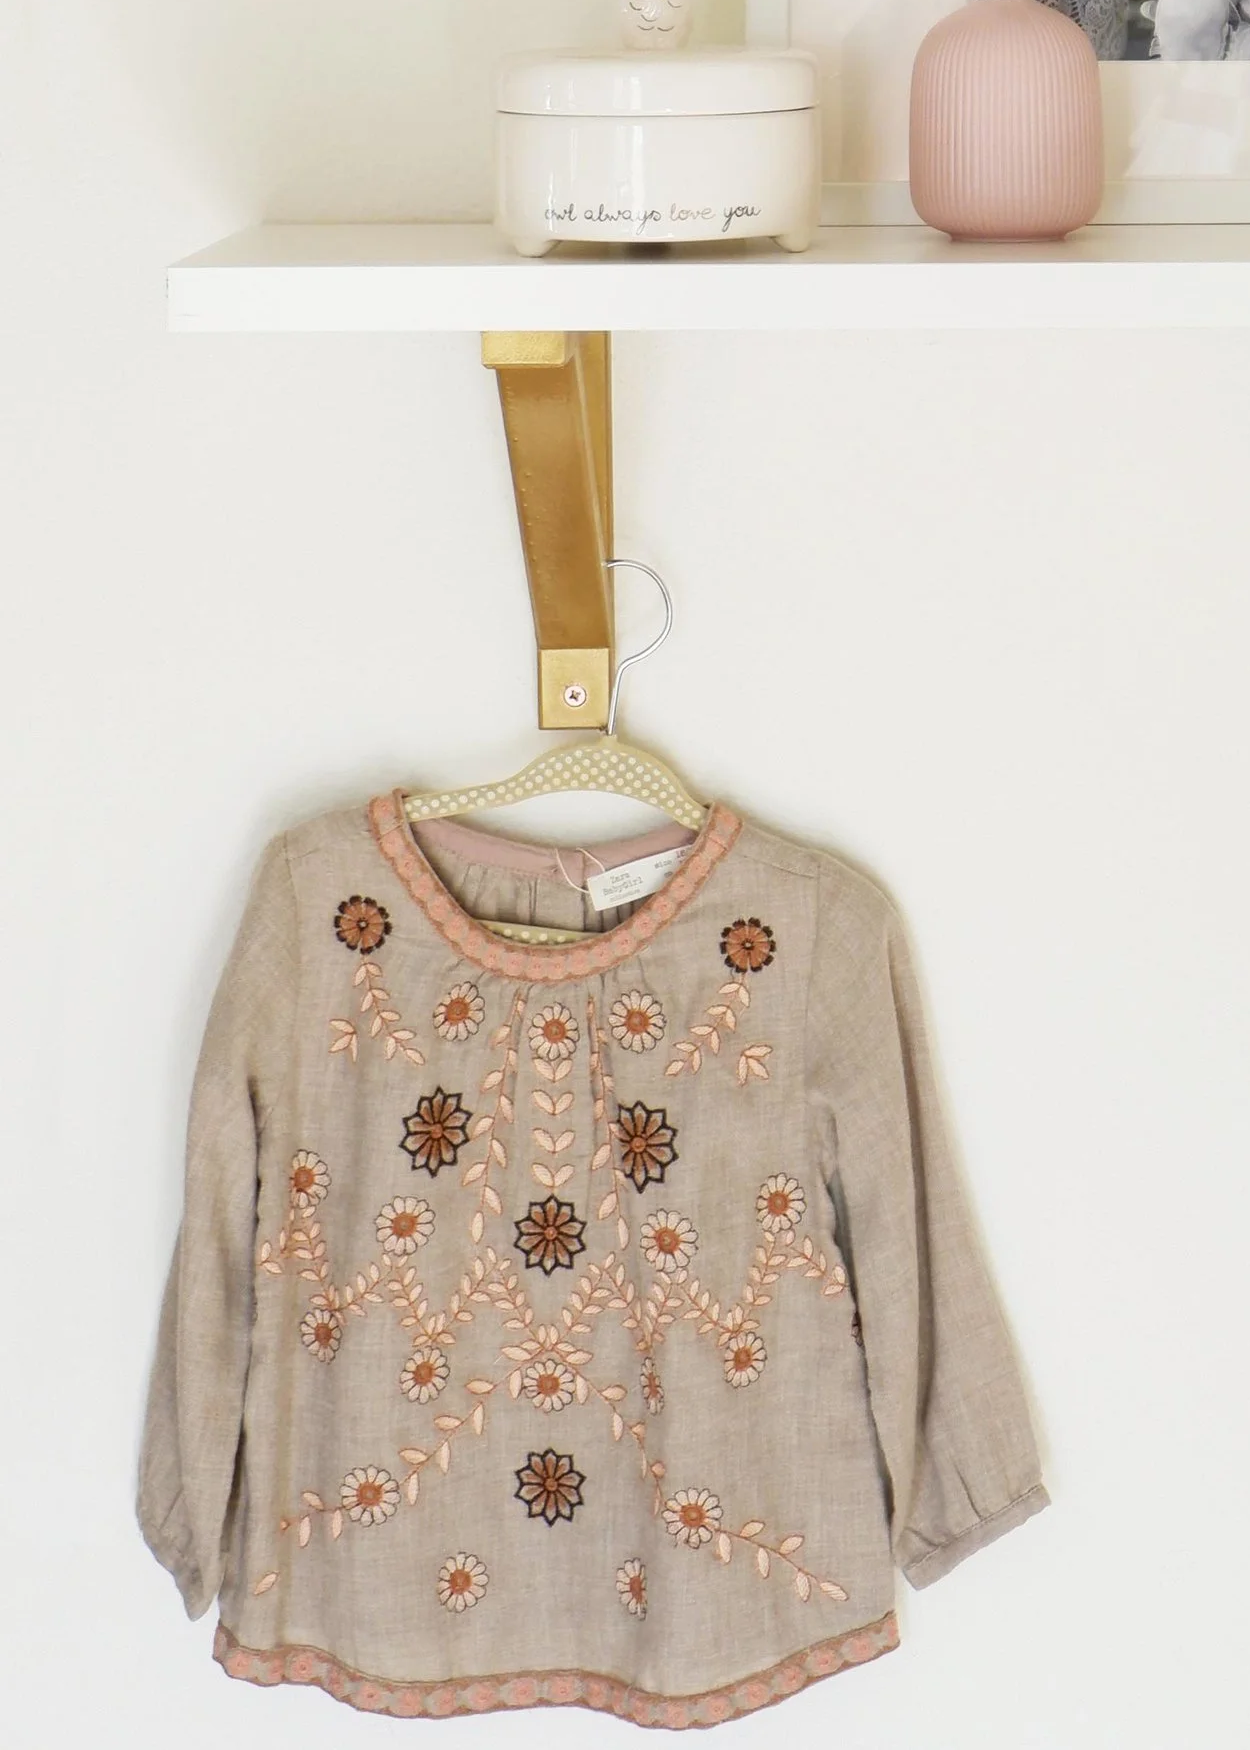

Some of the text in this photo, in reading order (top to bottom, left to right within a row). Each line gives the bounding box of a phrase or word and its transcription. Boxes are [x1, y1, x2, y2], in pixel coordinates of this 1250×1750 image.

[584, 203, 662, 235] always
[669, 202, 716, 222] love
[723, 202, 762, 233] you
